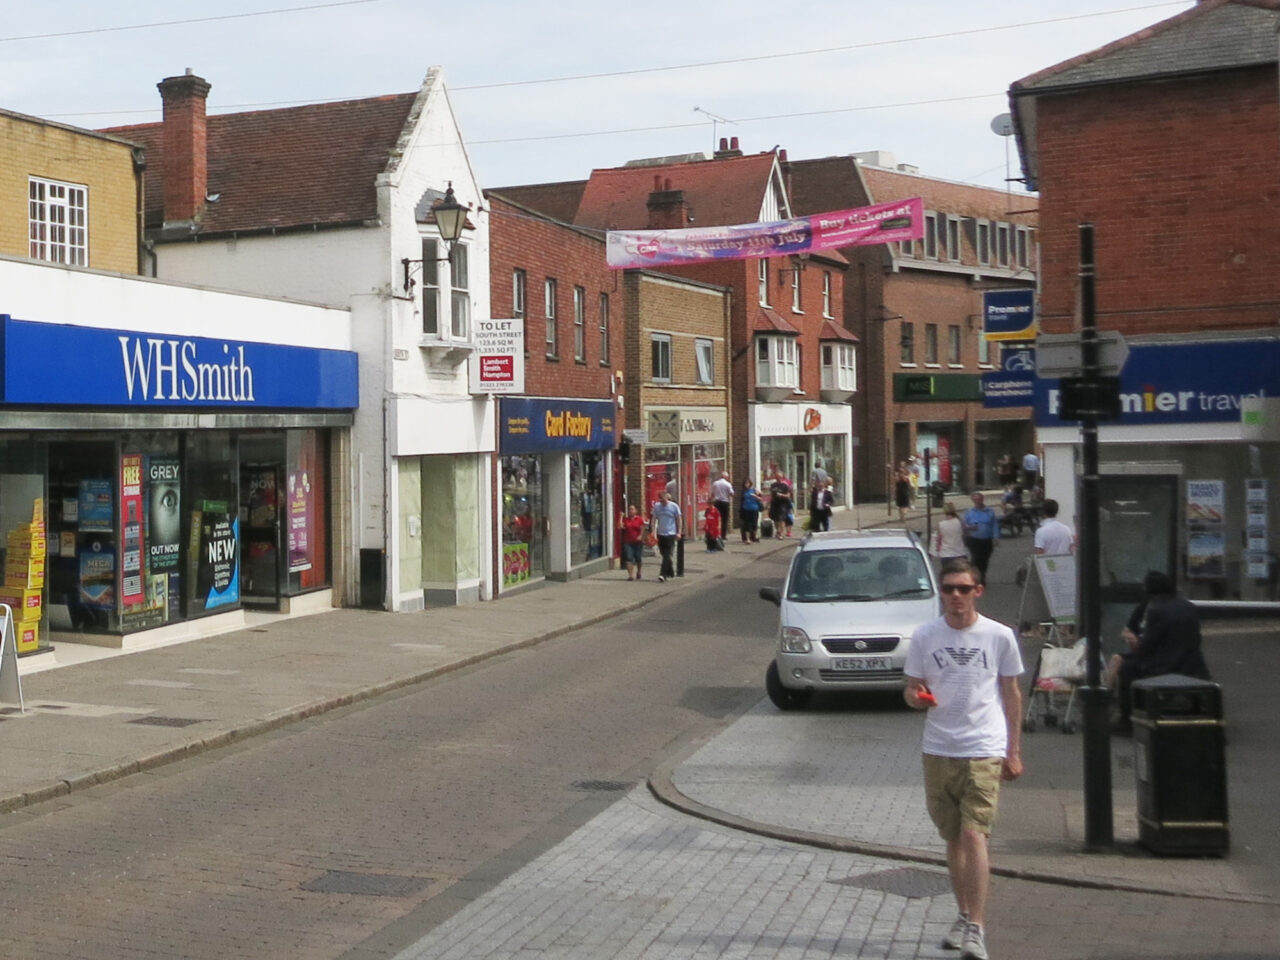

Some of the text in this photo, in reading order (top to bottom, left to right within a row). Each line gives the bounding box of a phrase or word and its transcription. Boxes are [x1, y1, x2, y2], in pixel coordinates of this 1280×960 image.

[819, 219, 846, 230] Buy
[987, 306, 1031, 314] Premier
[480, 322, 512, 331] TO LET
[118, 336, 255, 402] WHSmith
[1198, 389, 1264, 411] trav
[123, 466, 140, 486] FREE
[150, 465, 180, 480] GREY
[151, 543, 180, 556] OUT NOW
[208, 538, 236, 564] NEW
